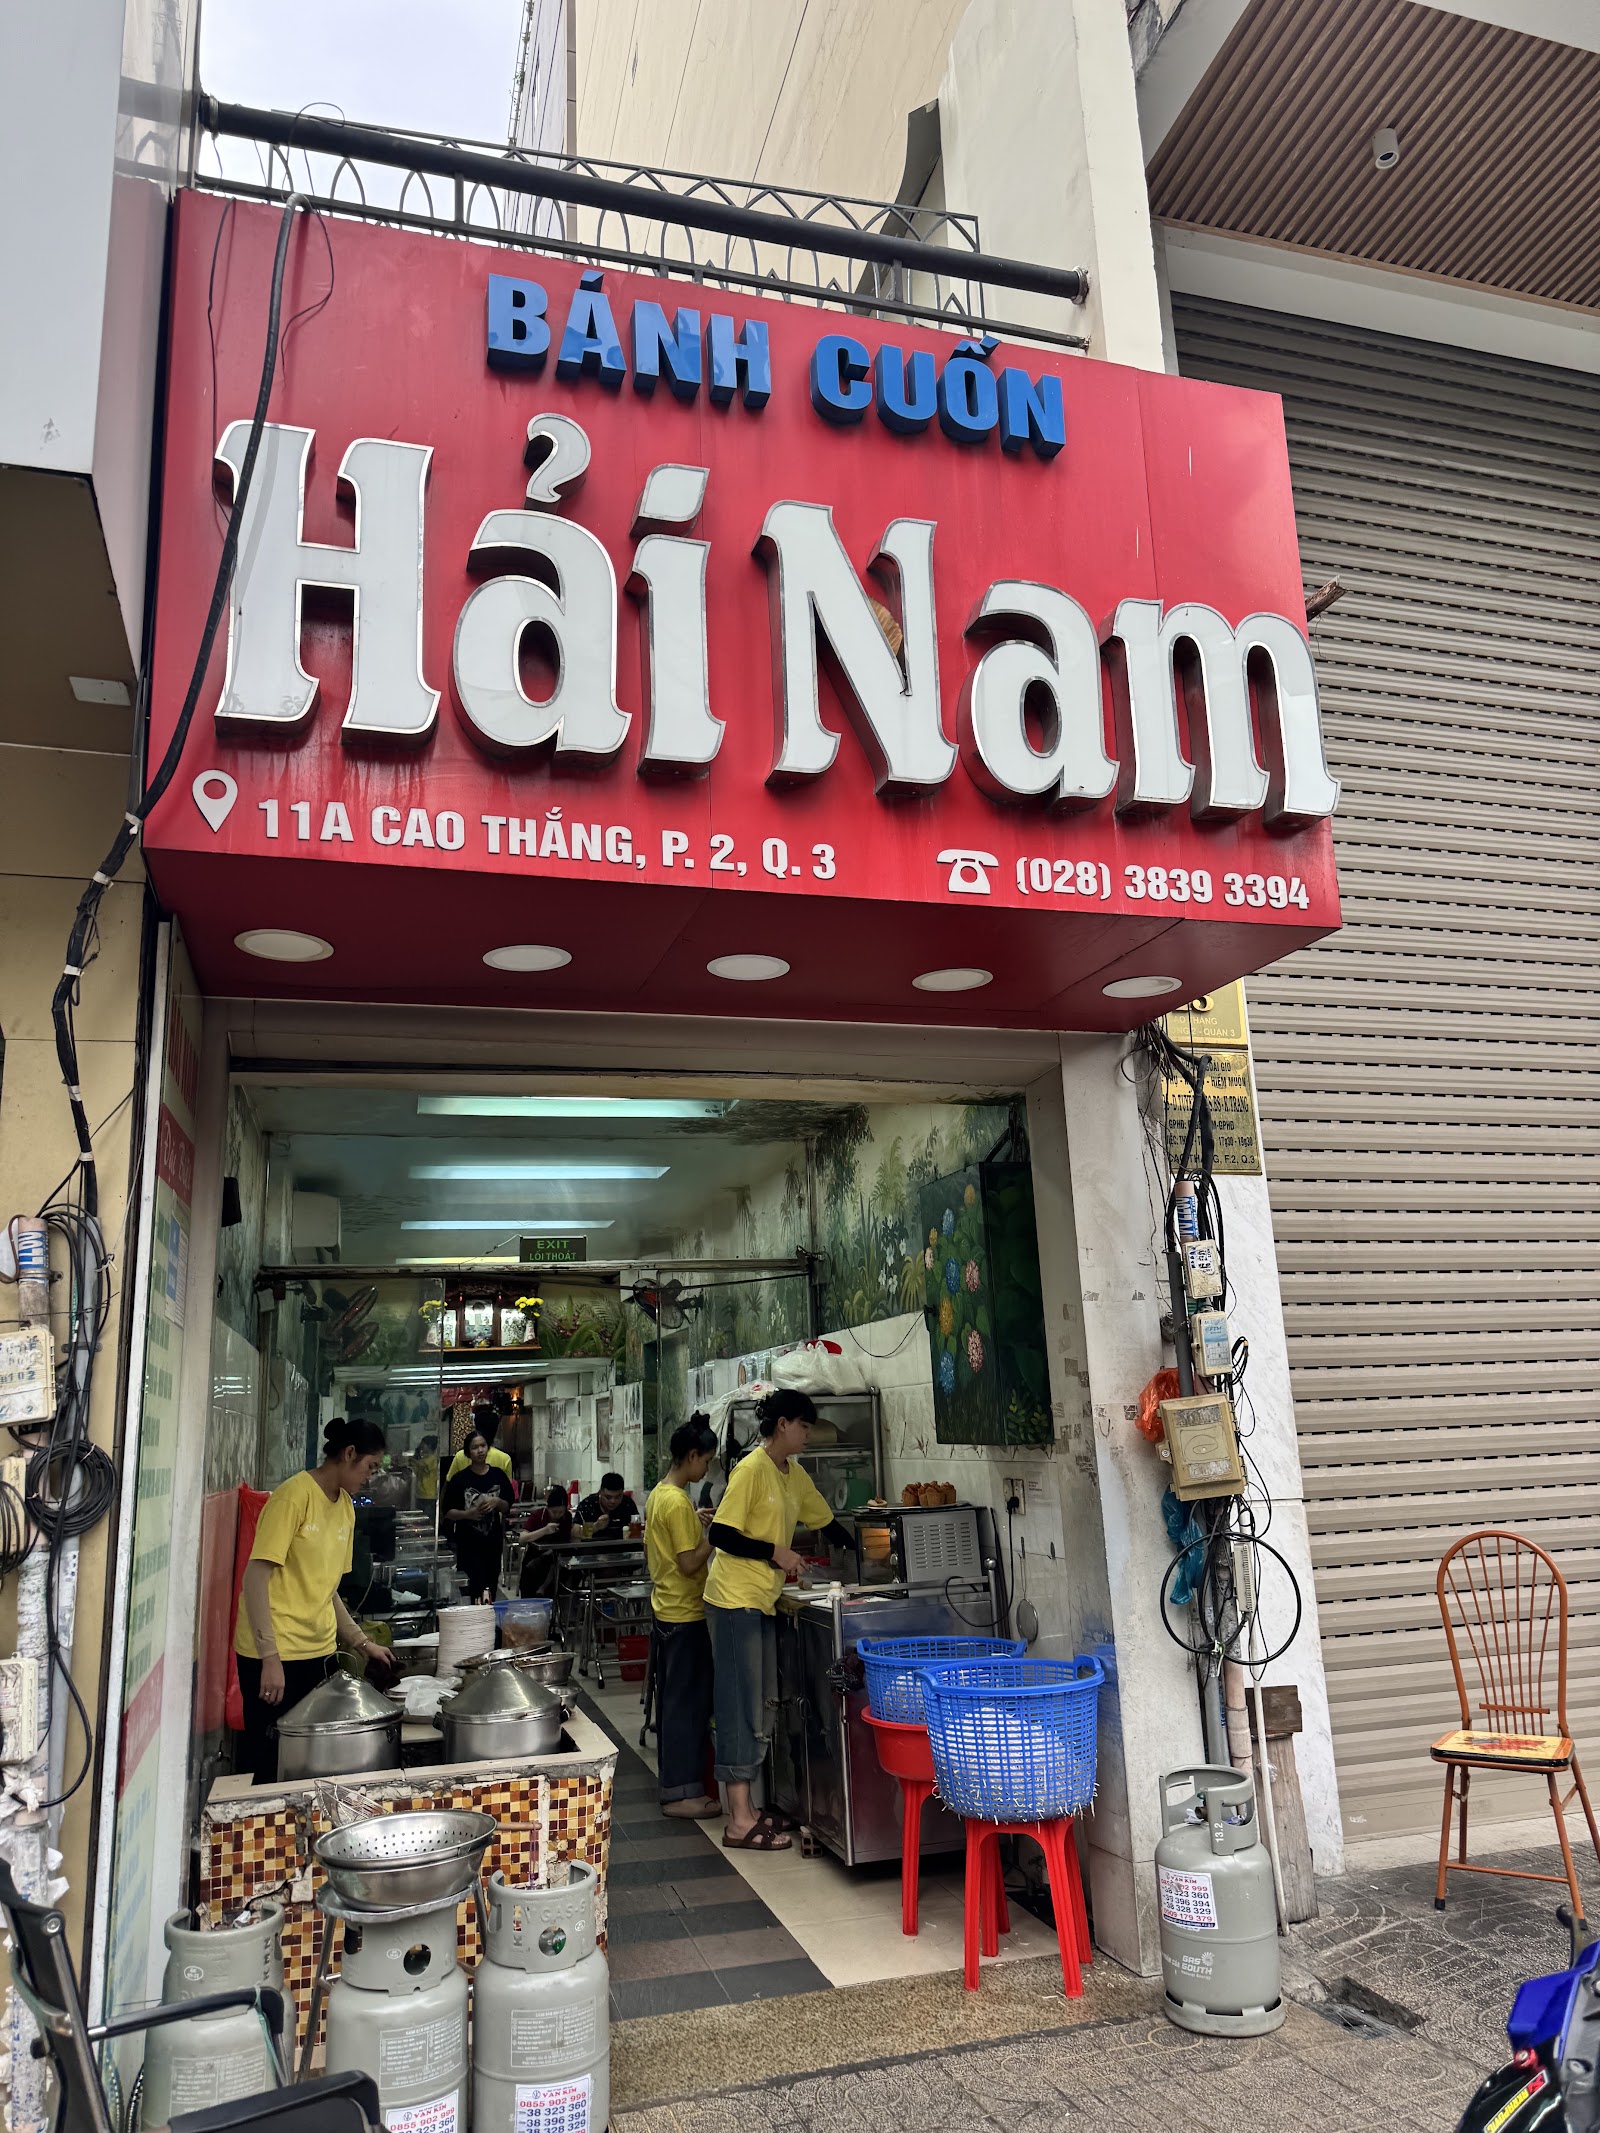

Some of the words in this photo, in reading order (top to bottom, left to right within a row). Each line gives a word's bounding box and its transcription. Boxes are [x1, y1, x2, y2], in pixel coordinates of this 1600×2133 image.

[487, 270, 771, 408] BÁNH
[810, 336, 1066, 458] CUỐN
[214, 412, 727, 768] Hải
[752, 500, 1341, 830] Nam
[258, 799, 354, 842] 11A
[371, 805, 465, 850] CAO
[480, 806, 646, 869] THẮNG,
[661, 829, 695, 869] P.
[710, 834, 748, 876] 2,
[761, 837, 801, 879] Q.
[811, 843, 836, 879] 3
[1016, 856, 1111, 900] (028)
[1123, 865, 1213, 903] 3839
[1222, 872, 1311, 910] 3394
[536, 1240, 569, 1249] EXIT
[545, 1250, 577, 1261] THOÁT
[1214, 1822, 1224, 1843] 13.2
[1174, 1897, 1190, 1906] 396
[1192, 1900, 1210, 1908] 394
[1191, 1891, 1210, 1899] 360
[1175, 1904, 1192, 1913] 328
[1193, 1907, 1211, 1915] 329
[1181, 1962, 1213, 1975] SOUTH
[1182, 1955, 1202, 1966] GAS
[520, 2100, 545, 2108] 0855
[549, 2098, 567, 2106] 902
[570, 2091, 586, 2102] 999
[544, 2106, 565, 2116] 323
[568, 2099, 587, 2112] 360
[390, 2121, 417, 2132] 0855
[420, 2115, 438, 2126] 902
[440, 2107, 455, 2118] 999
[438, 2114, 455, 2130] 360
[544, 2116, 565, 2126] 396
[568, 2109, 586, 2122] 394
[567, 2119, 586, 2131] 329
